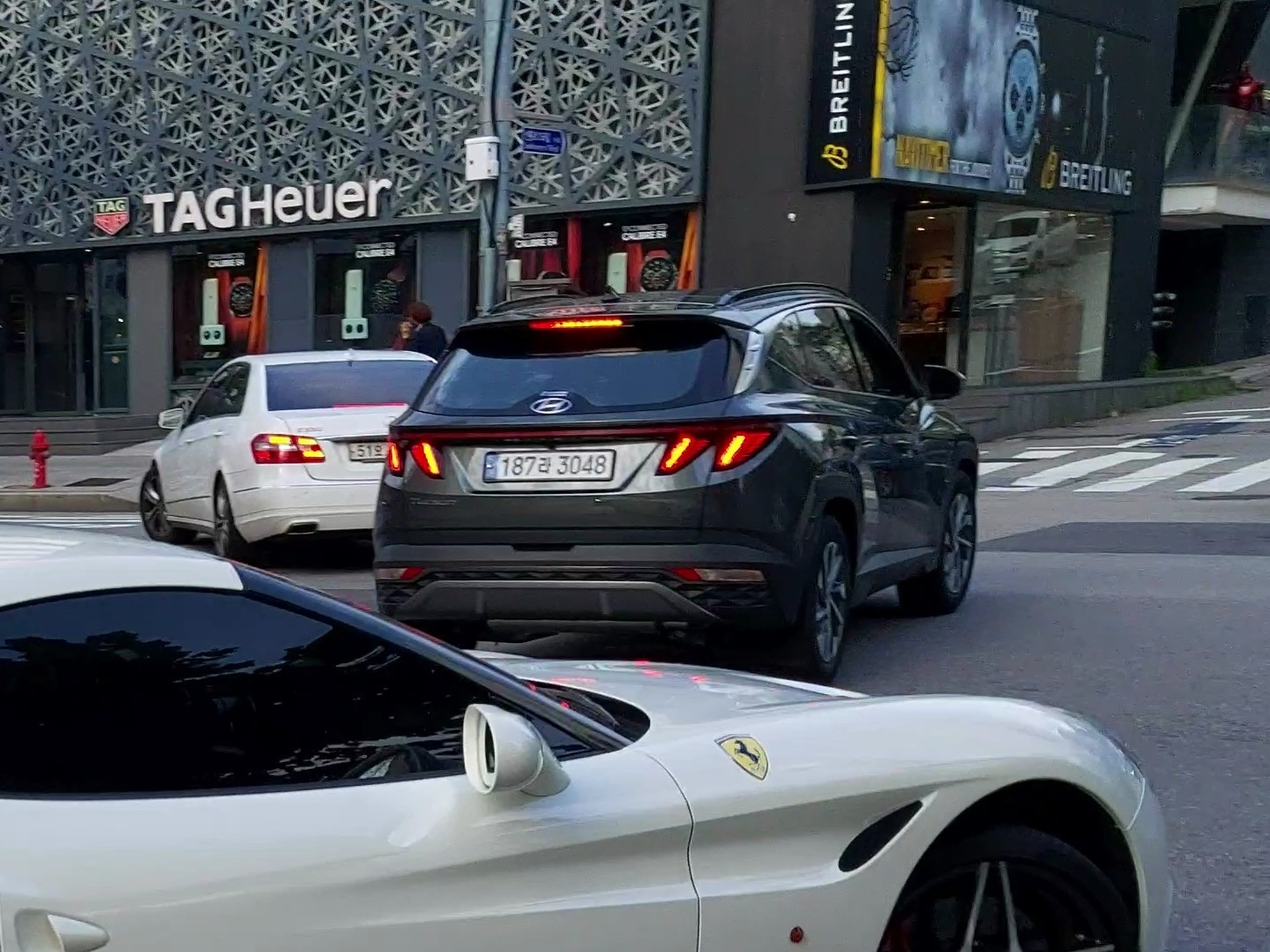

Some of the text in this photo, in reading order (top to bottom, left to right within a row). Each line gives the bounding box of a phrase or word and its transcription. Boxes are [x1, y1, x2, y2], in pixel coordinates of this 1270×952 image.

[1059, 160, 1132, 196] BREITLING
[96, 200, 125, 213] TAG
[501, 454, 608, 477] 187라 3048
